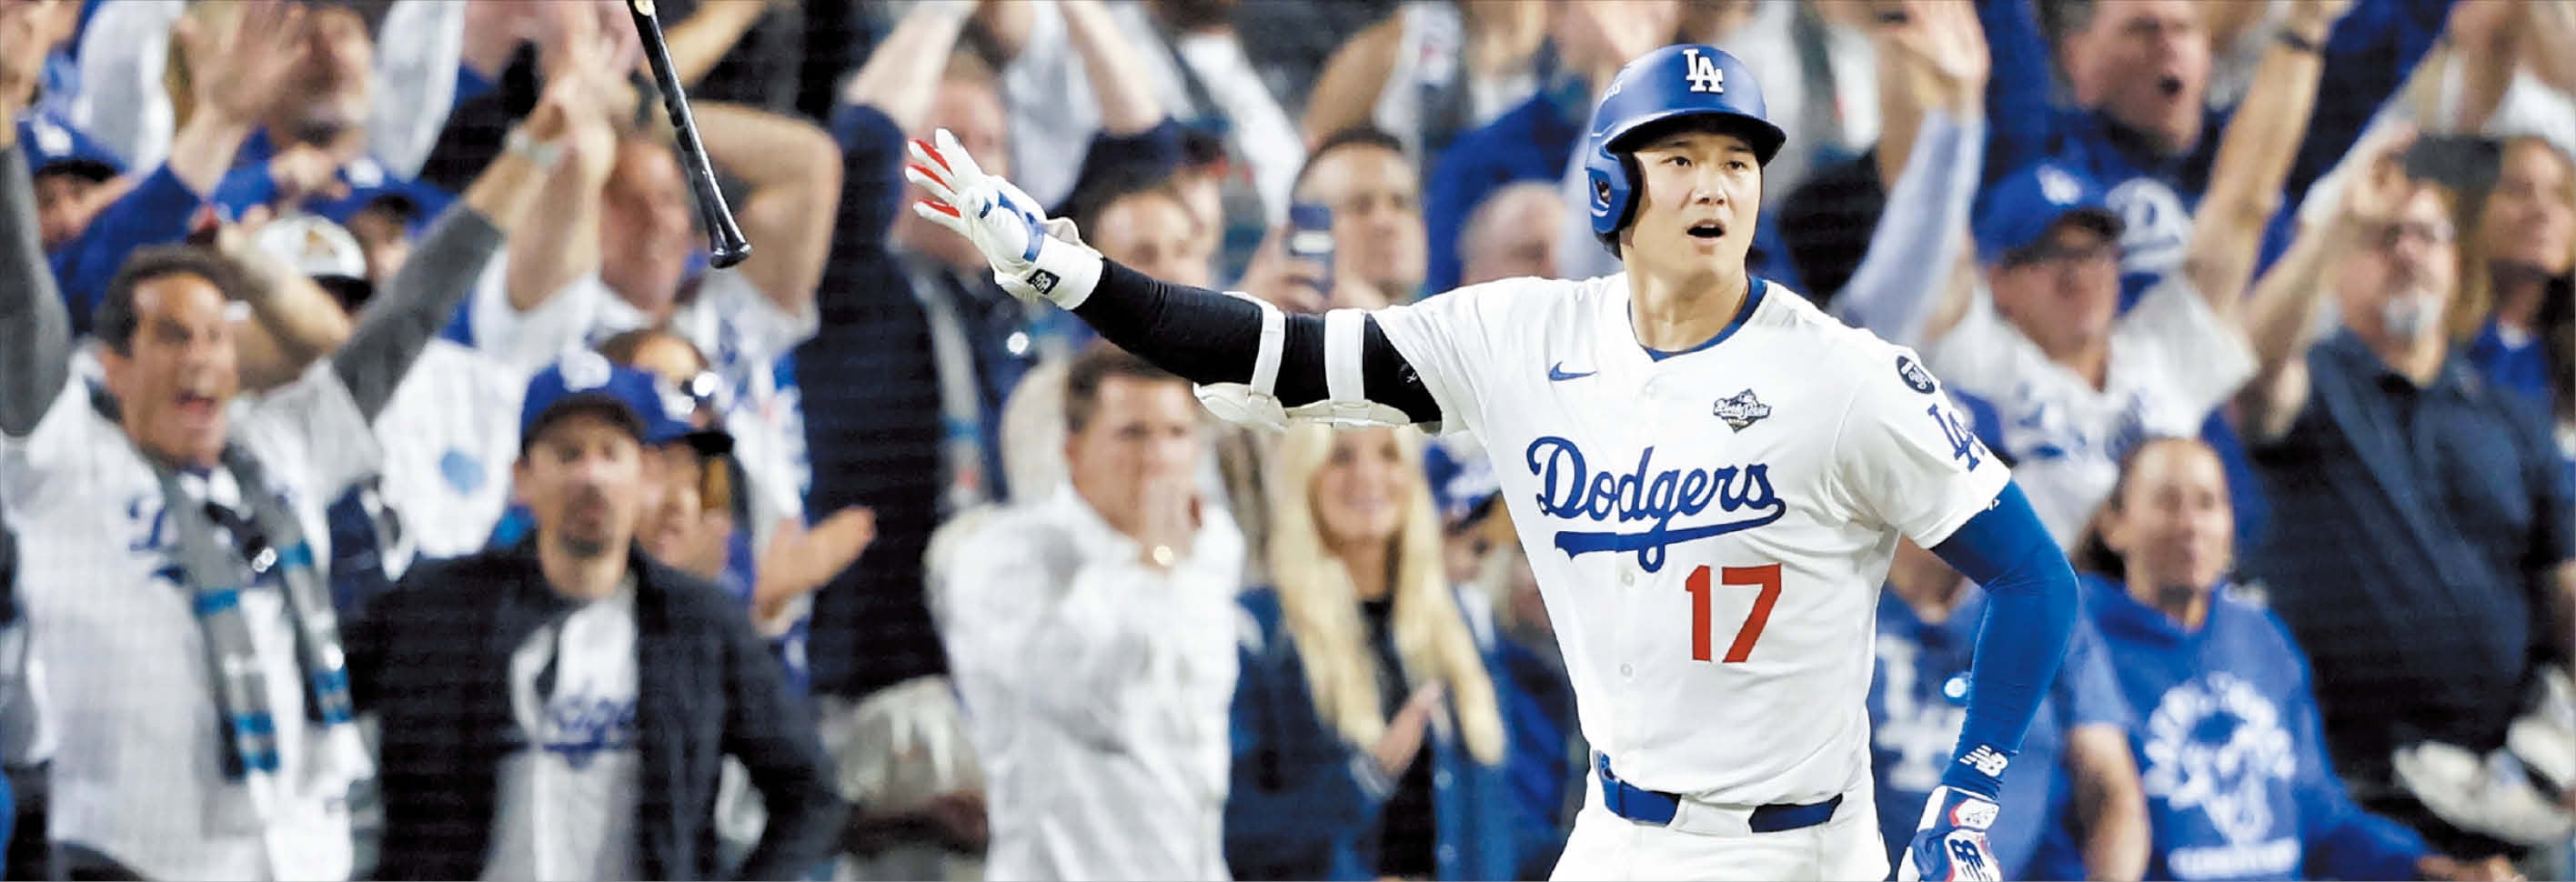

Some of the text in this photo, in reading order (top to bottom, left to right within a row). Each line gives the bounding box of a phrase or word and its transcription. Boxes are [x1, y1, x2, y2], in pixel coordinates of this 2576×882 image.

[1683, 48, 1725, 93] LA
[1927, 403, 1985, 472] LA
[1526, 436, 1786, 573] Dodgers
[1685, 563, 1782, 663] 17
